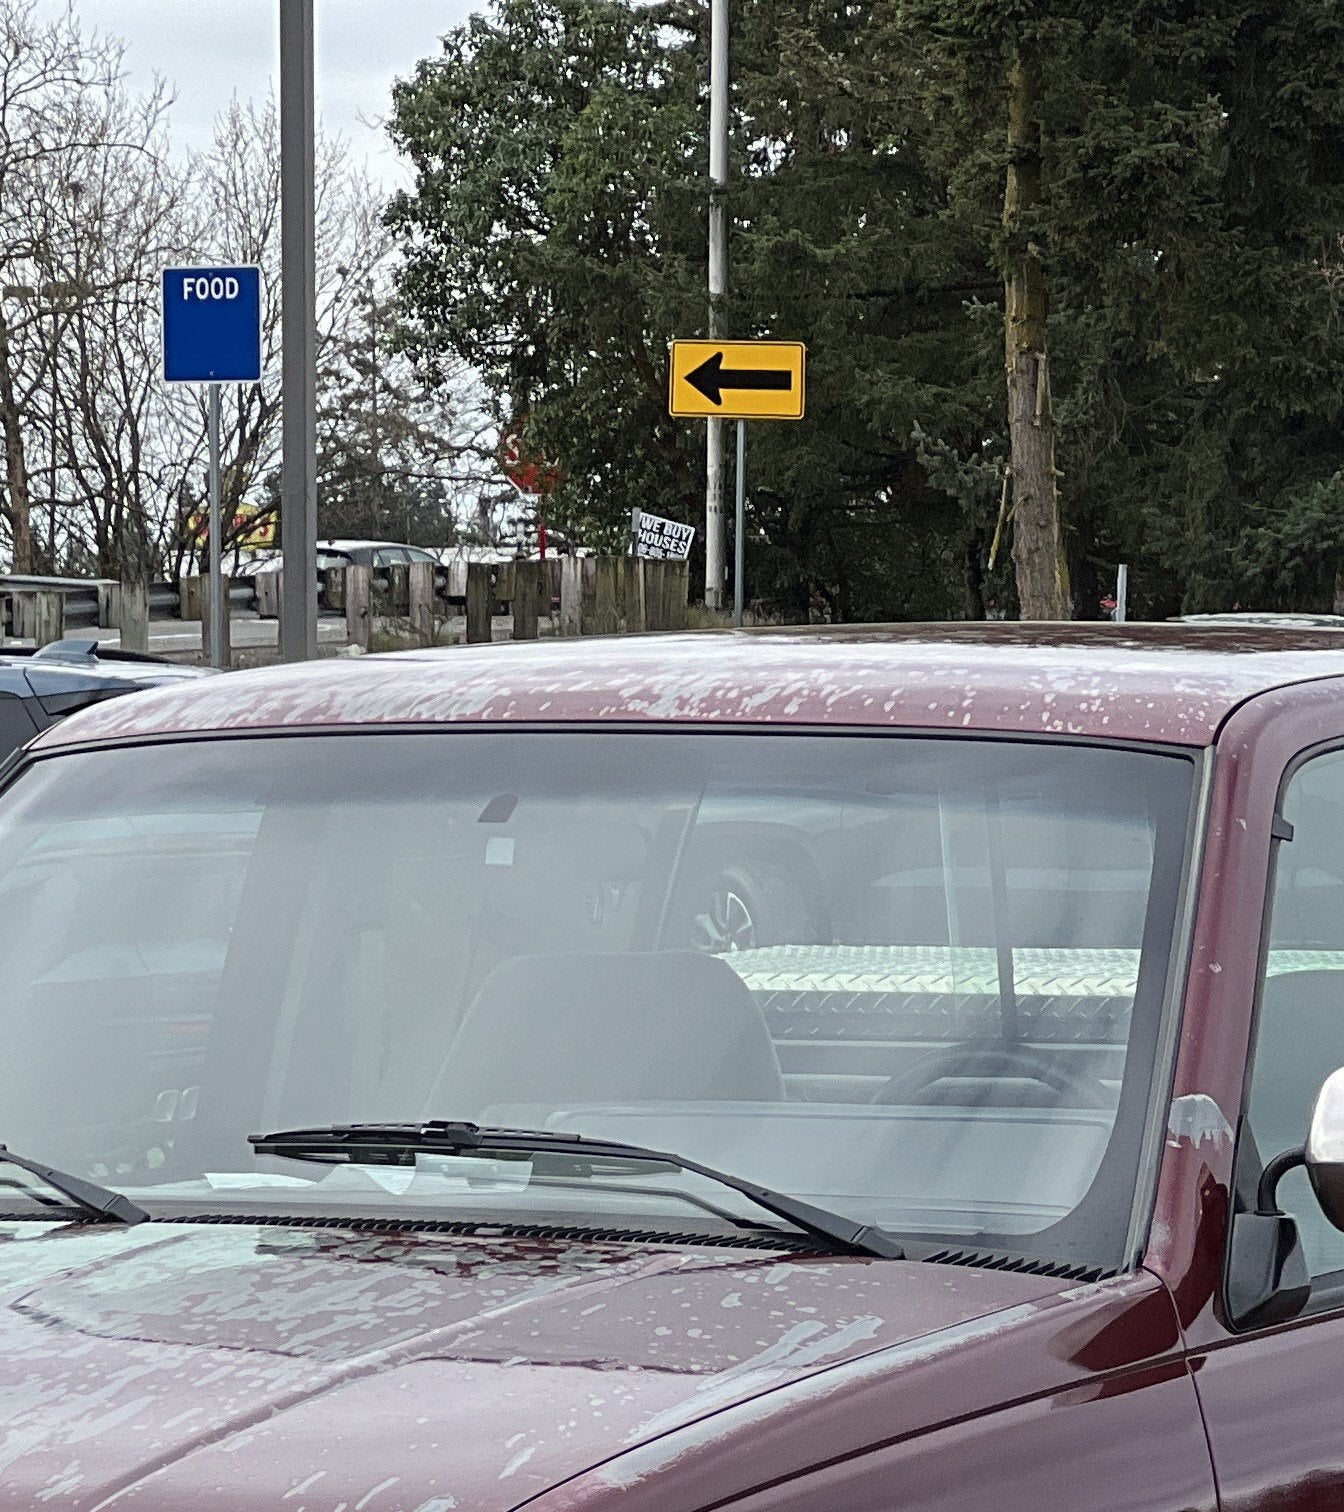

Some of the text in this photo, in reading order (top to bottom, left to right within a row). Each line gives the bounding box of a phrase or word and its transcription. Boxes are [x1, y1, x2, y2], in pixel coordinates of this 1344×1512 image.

[183, 277, 239, 300] FOOD
[640, 516, 690, 540] WE BUY
[638, 529, 687, 554] HOUSES
